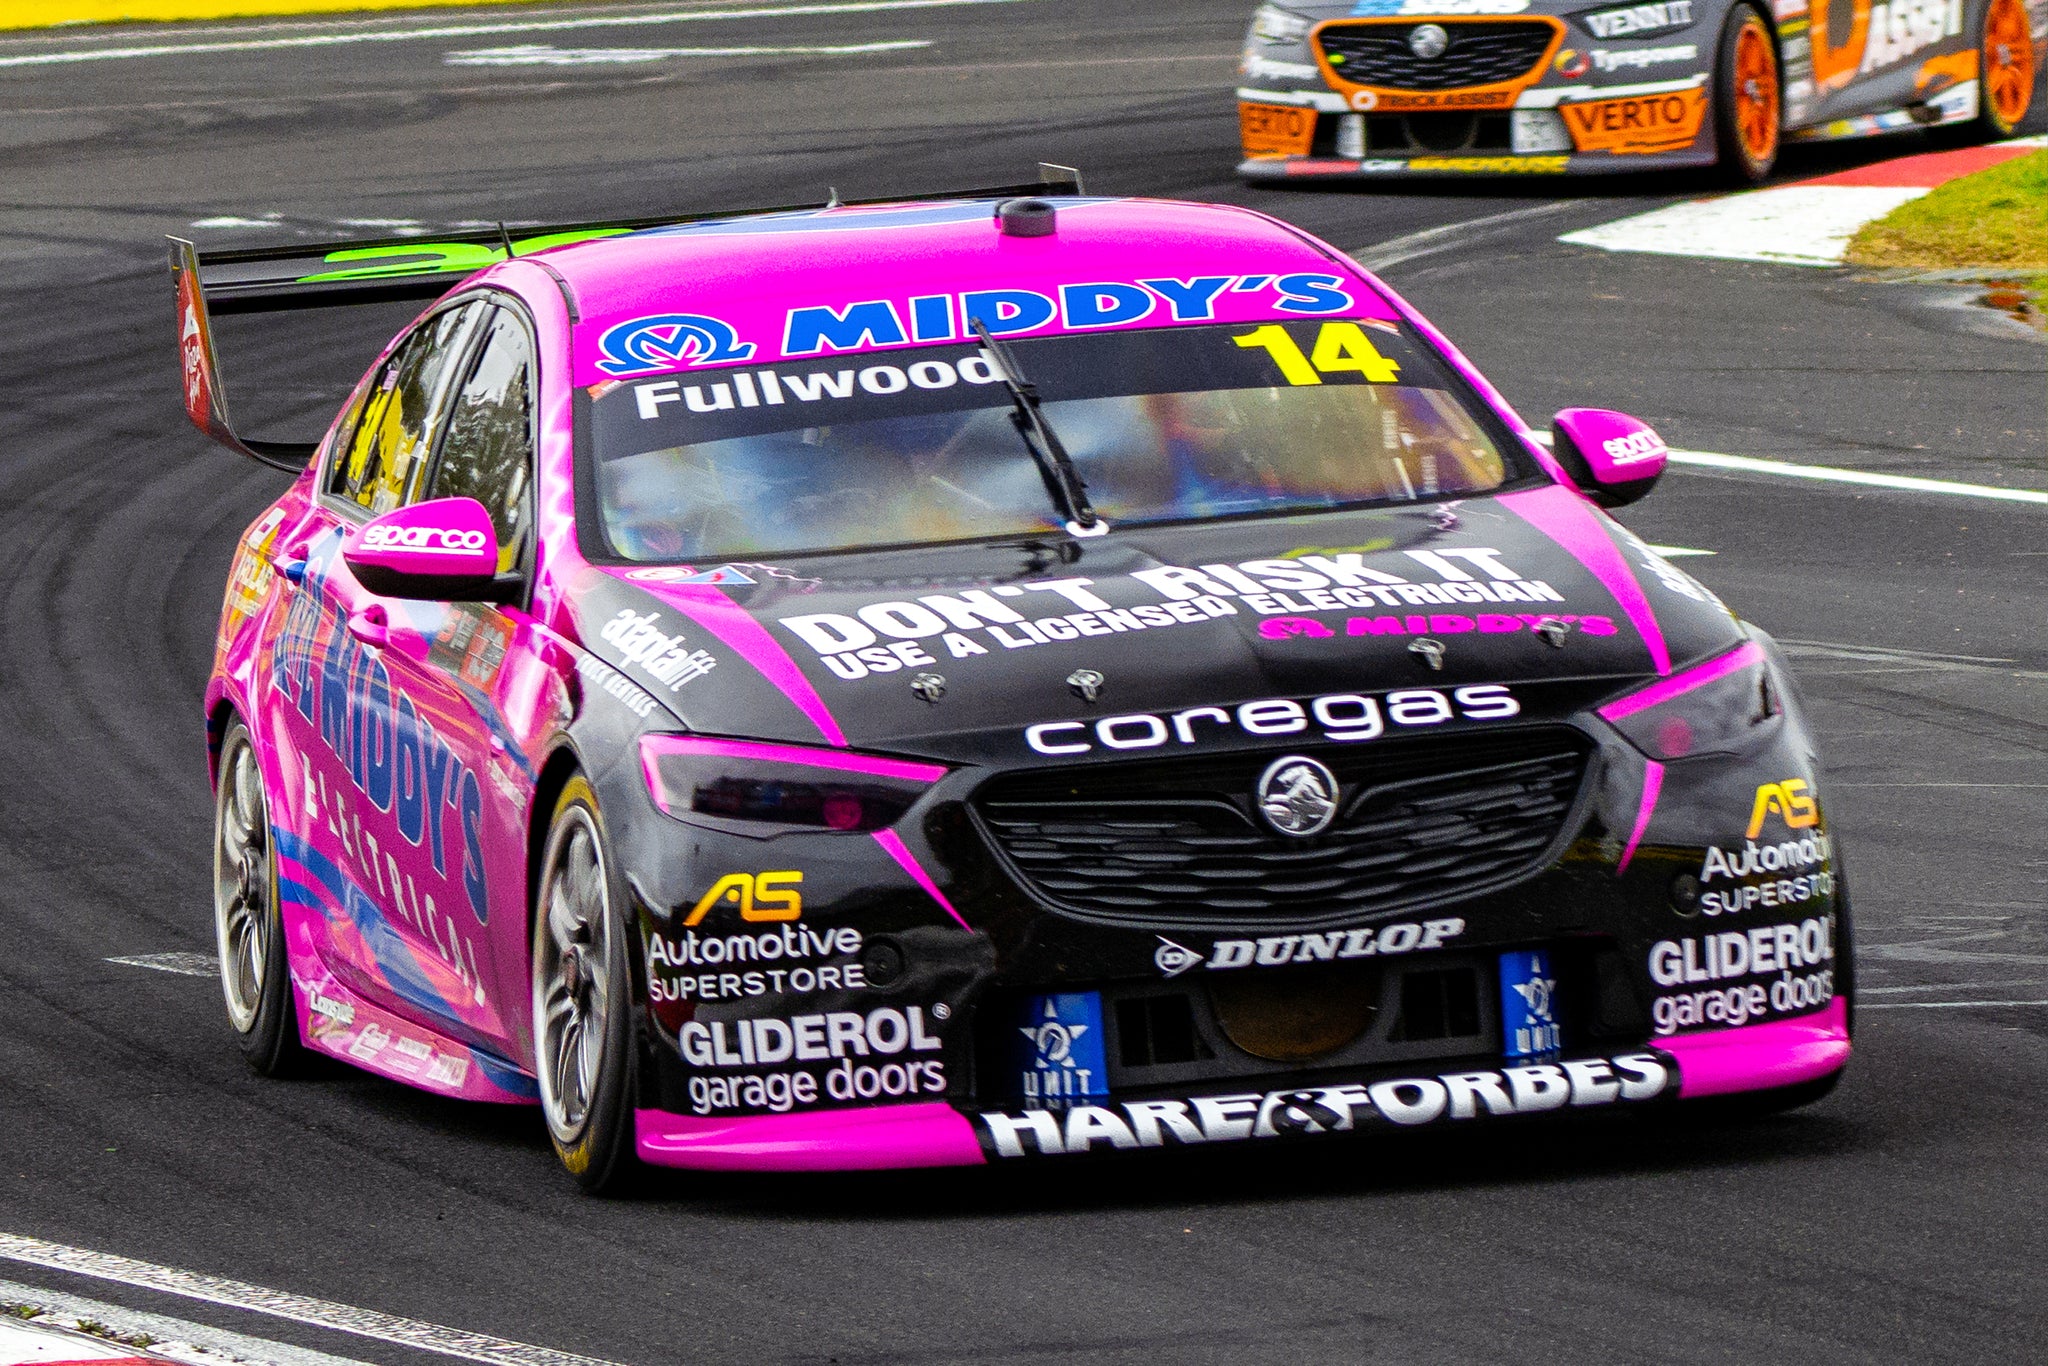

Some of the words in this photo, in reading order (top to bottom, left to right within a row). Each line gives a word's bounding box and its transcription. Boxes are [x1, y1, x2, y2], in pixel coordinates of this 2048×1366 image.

[1573, 96, 1686, 133] VERTO
[780, 273, 1356, 357] MIDDY'S
[633, 349, 1008, 420] Fullwood
[1232, 322, 1401, 386] 14
[363, 524, 487, 552] sparco
[778, 577, 1112, 656] DON'T
[1129, 553, 1408, 601] RISK
[1404, 546, 1527, 583] IT
[819, 640, 937, 681] USE
[942, 632, 989, 659] A
[986, 596, 1239, 650] LICENSED
[1238, 580, 1566, 617] ELECTRICIAN
[1024, 684, 1521, 755] coregas
[300, 750, 486, 1008] ELECTRICAL
[647, 922, 864, 968] Automotive
[1205, 917, 1466, 970] DUNLOP
[650, 963, 868, 1003] SUPERSTORE
[1652, 983, 1768, 1035] garage
[679, 1004, 942, 1068] GLIDEROL
[688, 1070, 819, 1116] garage
[825, 1058, 947, 1101] doors
[1022, 1068, 1093, 1097] UNIT
